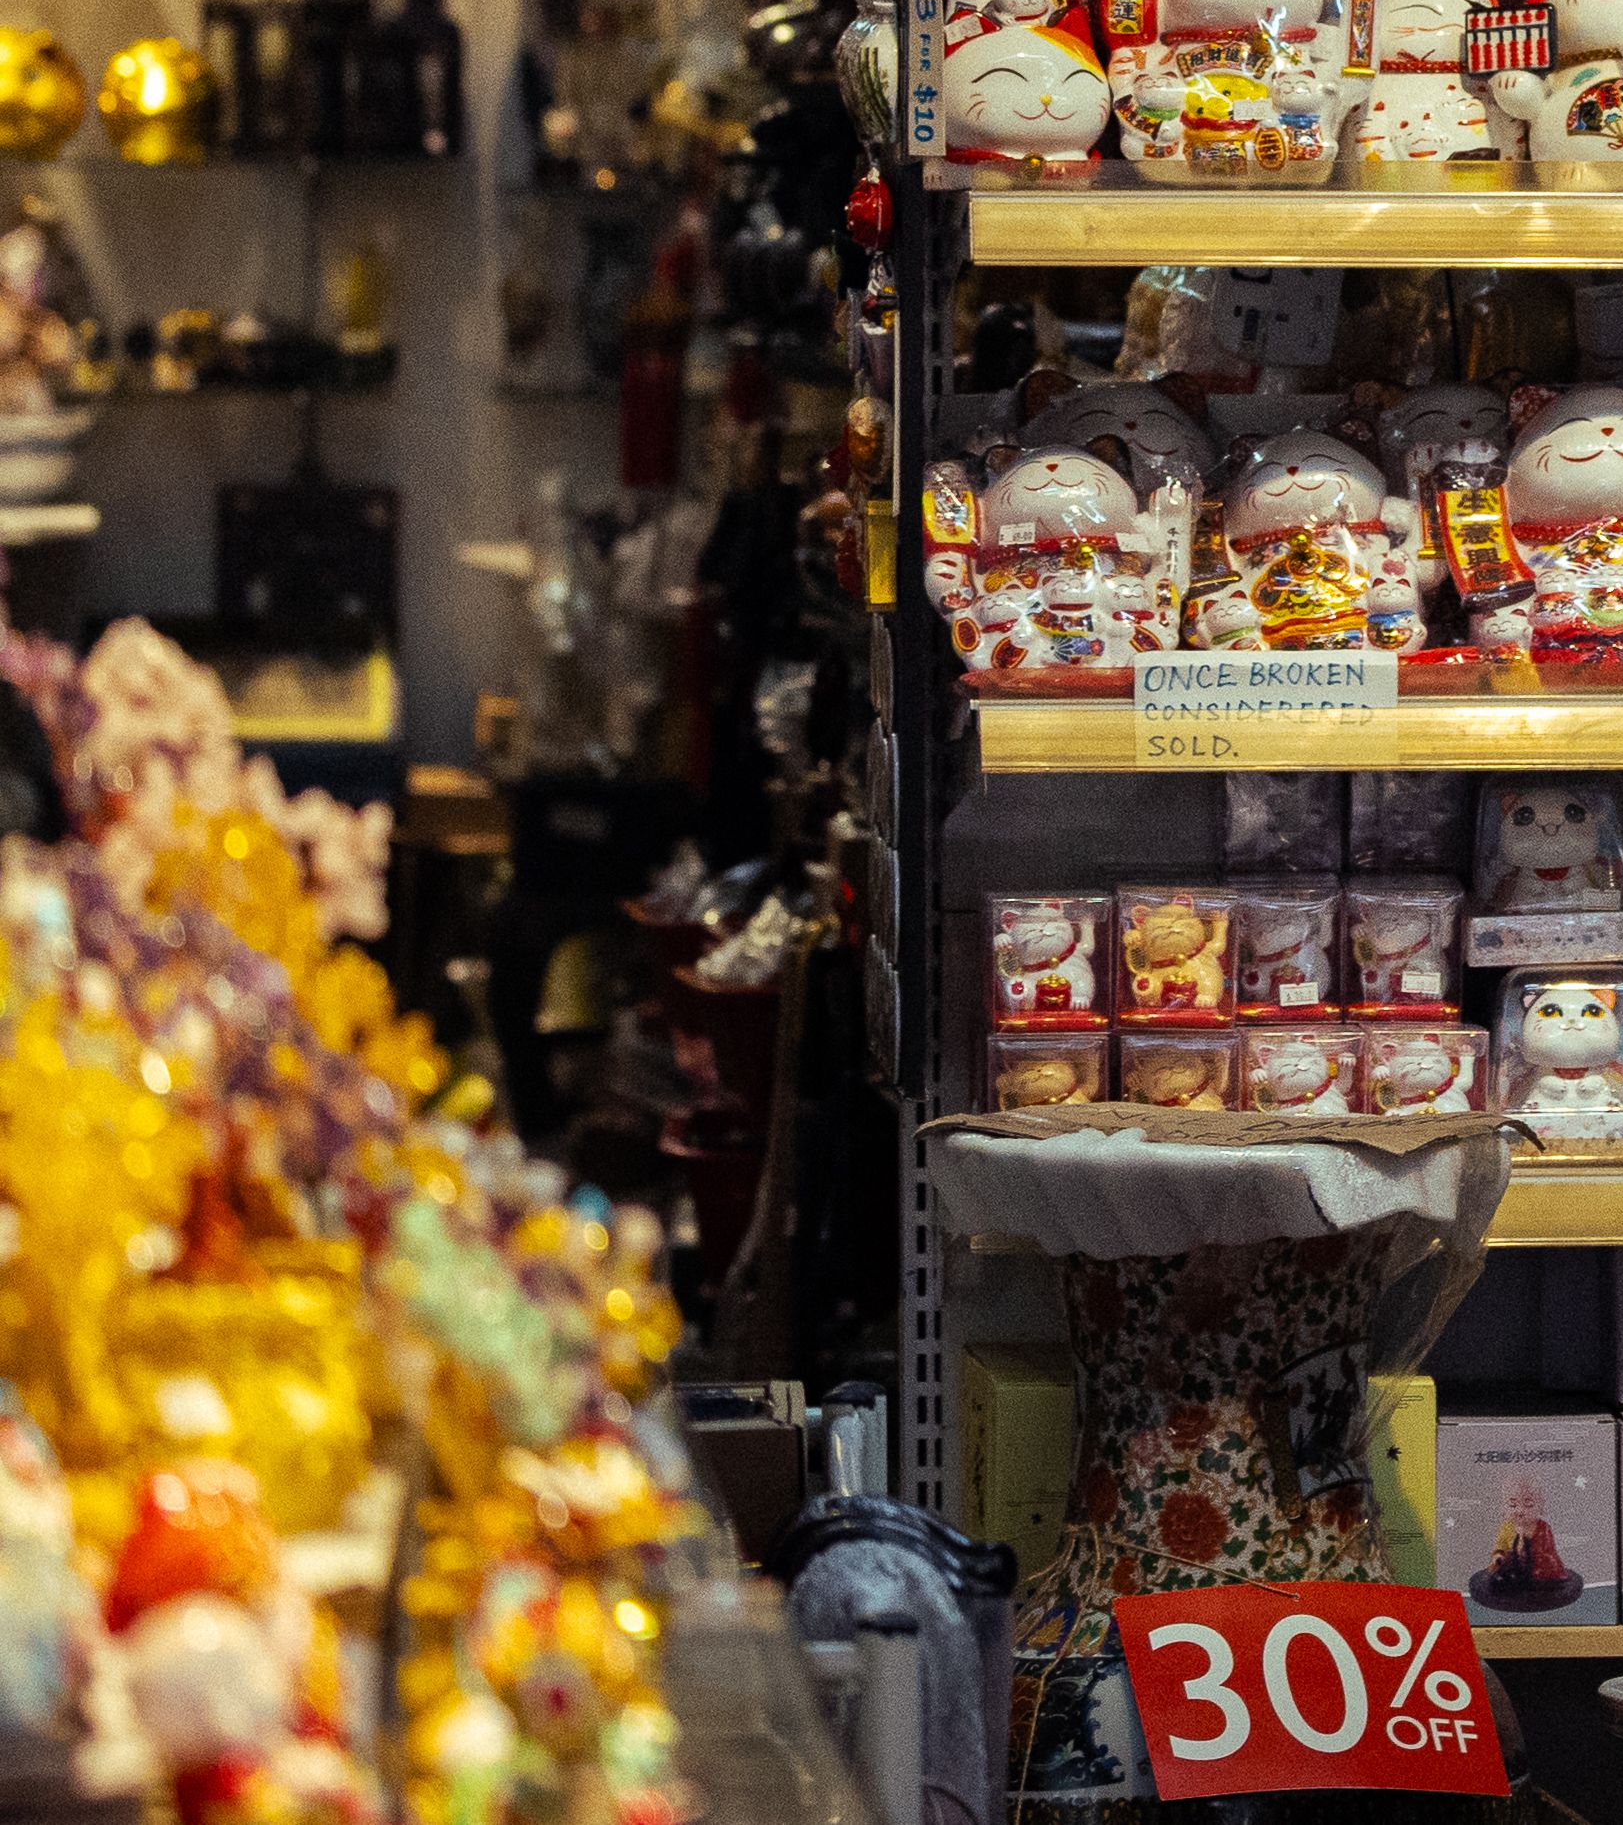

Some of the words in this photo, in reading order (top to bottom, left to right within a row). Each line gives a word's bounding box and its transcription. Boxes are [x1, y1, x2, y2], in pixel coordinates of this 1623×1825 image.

[912, 84, 936, 142] $10
[1143, 663, 1238, 692] ONCE
[1249, 659, 1365, 687] BROKEN
[1148, 735, 1240, 758] SOLD.
[1148, 1614, 1472, 1761] 30%
[1385, 1715, 1479, 1754] OFF
